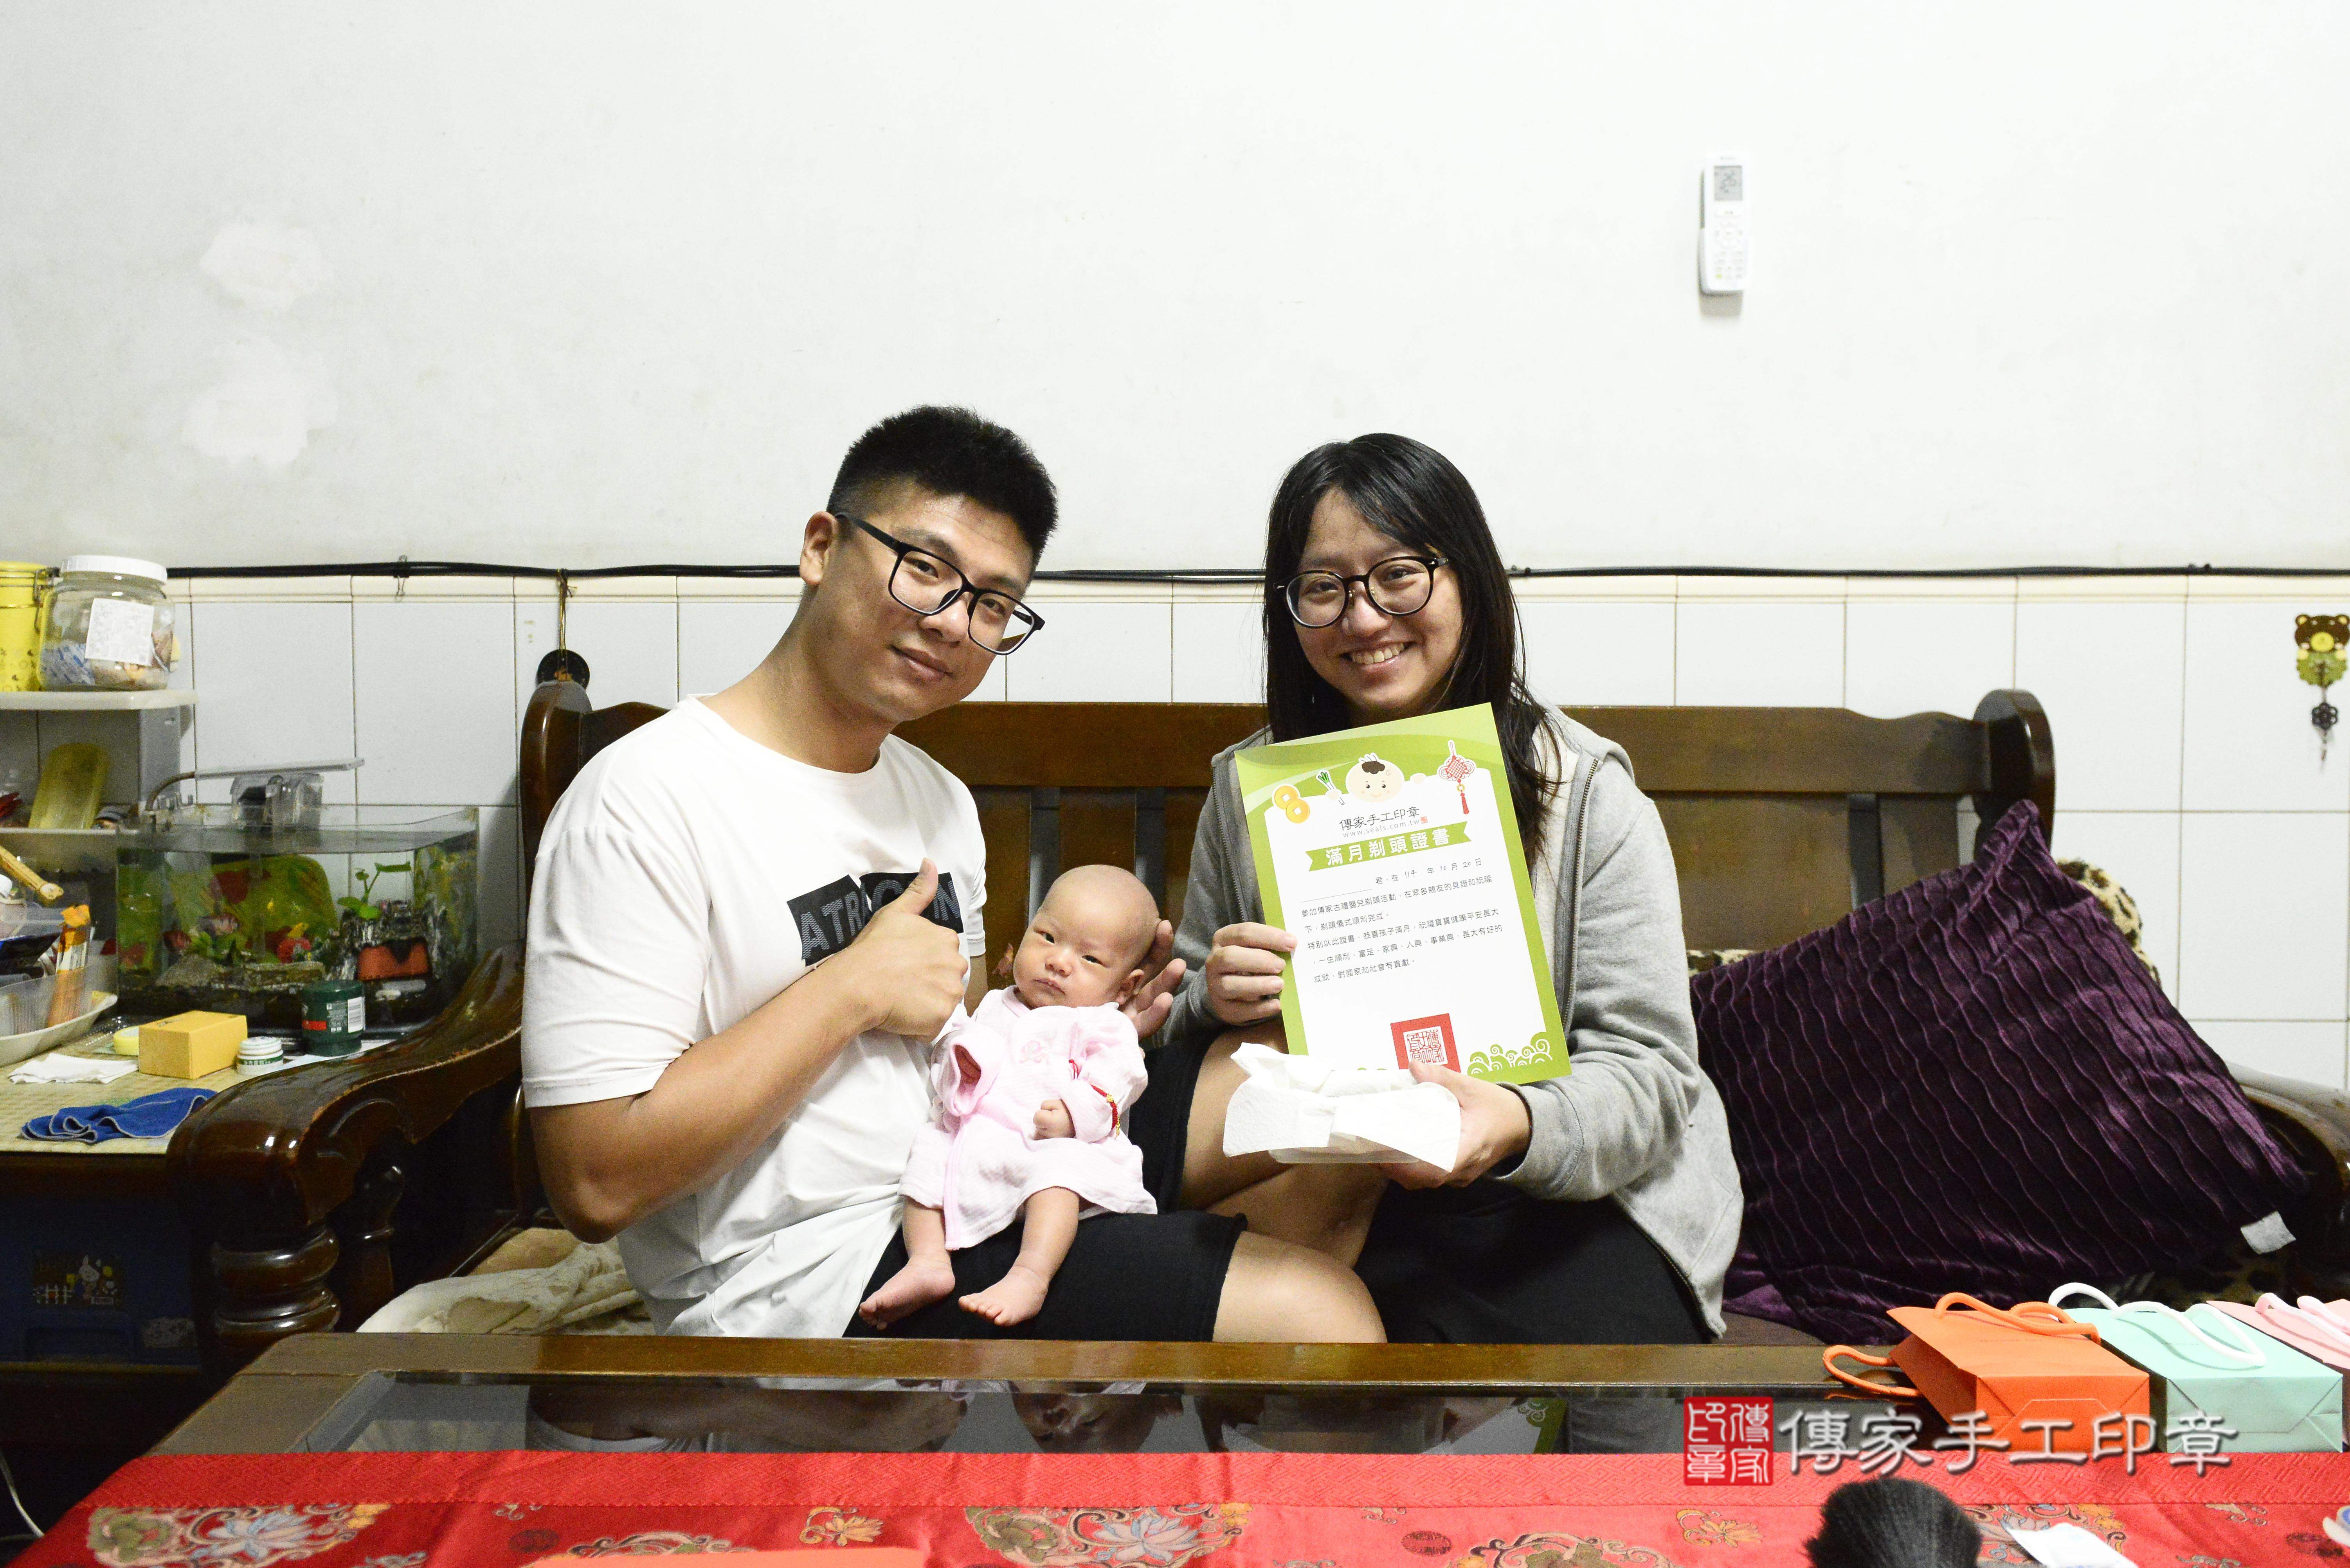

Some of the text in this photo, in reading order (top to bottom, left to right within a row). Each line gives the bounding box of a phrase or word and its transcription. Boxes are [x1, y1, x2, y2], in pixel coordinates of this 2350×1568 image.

[1340, 806, 1419, 831] 傳家手工印章
[1342, 819, 1420, 838] www.seals.com.tw
[1325, 828, 1450, 866] 滿月剃頭證書
